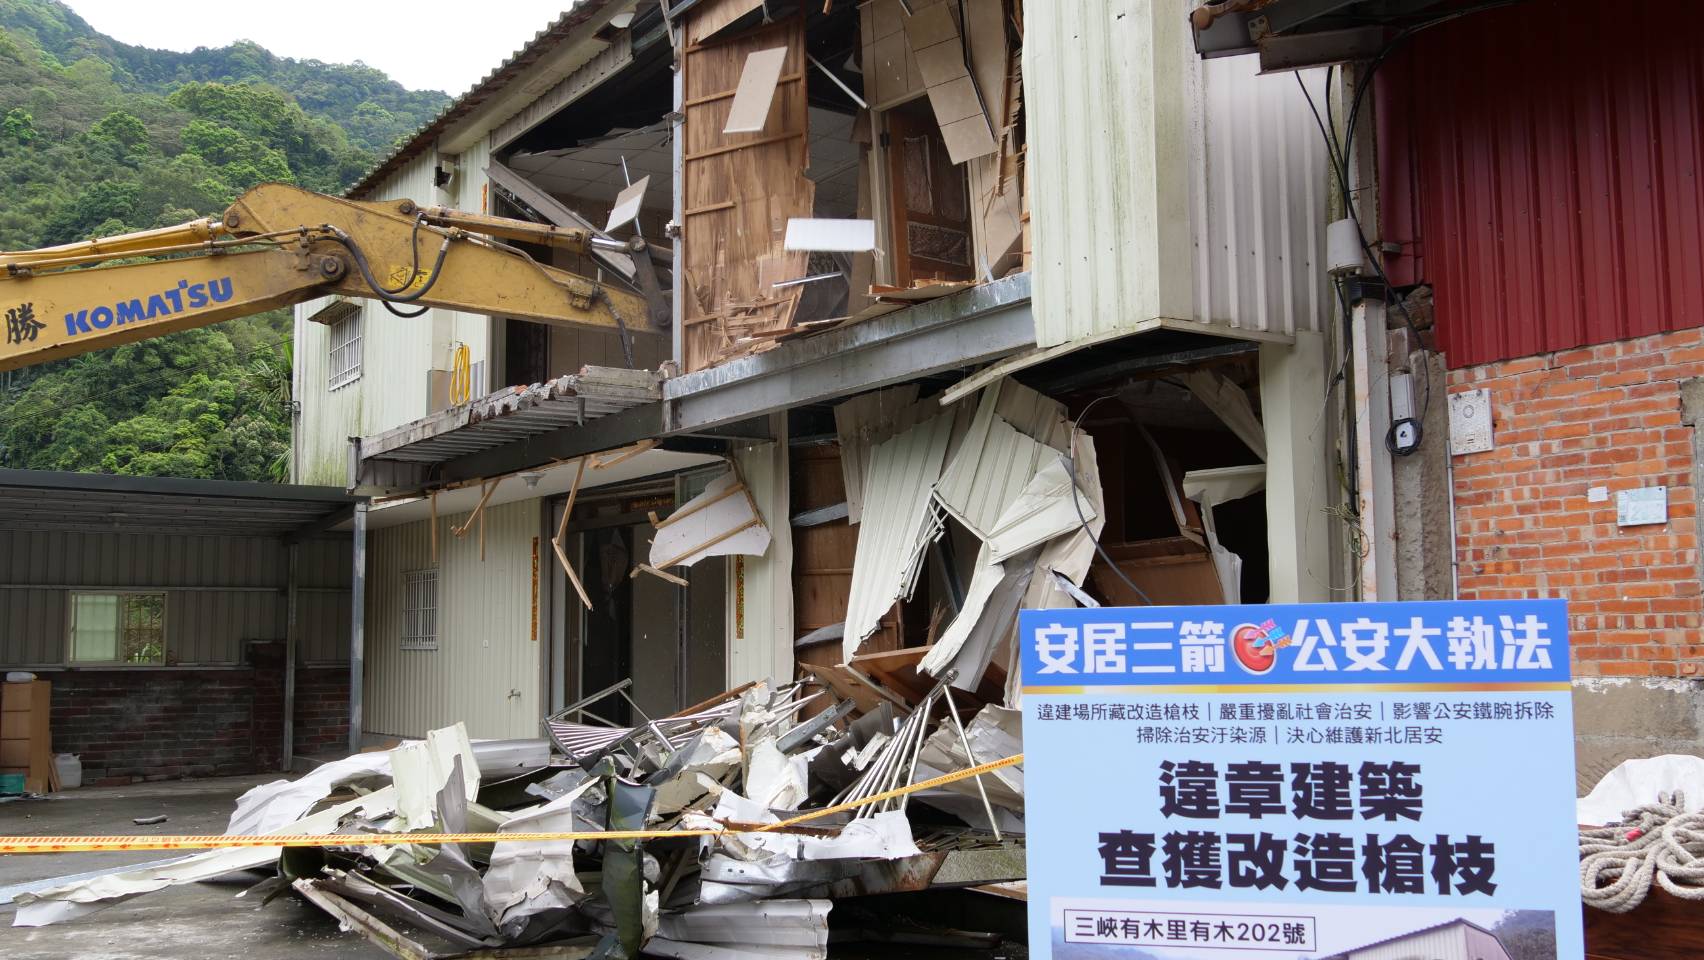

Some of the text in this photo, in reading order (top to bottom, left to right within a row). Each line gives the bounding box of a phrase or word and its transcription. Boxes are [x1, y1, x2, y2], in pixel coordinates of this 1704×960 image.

[5, 302, 47, 344] 勝
[64, 277, 234, 336] KOMATSU
[1035, 615, 1553, 673] 安居三箭 公安大執法
[1037, 701, 1555, 721] 違建場所藏改造槍枝 嚴重擾亂社會治安 影響公安鐵腕拆除
[1286, 725, 1443, 745] 決心維護新北居安
[1159, 760, 1424, 822] 違章建築
[1098, 829, 1498, 897] 查獲改造槍枝
[1075, 916, 1306, 946] 三峽有木里有木202號
